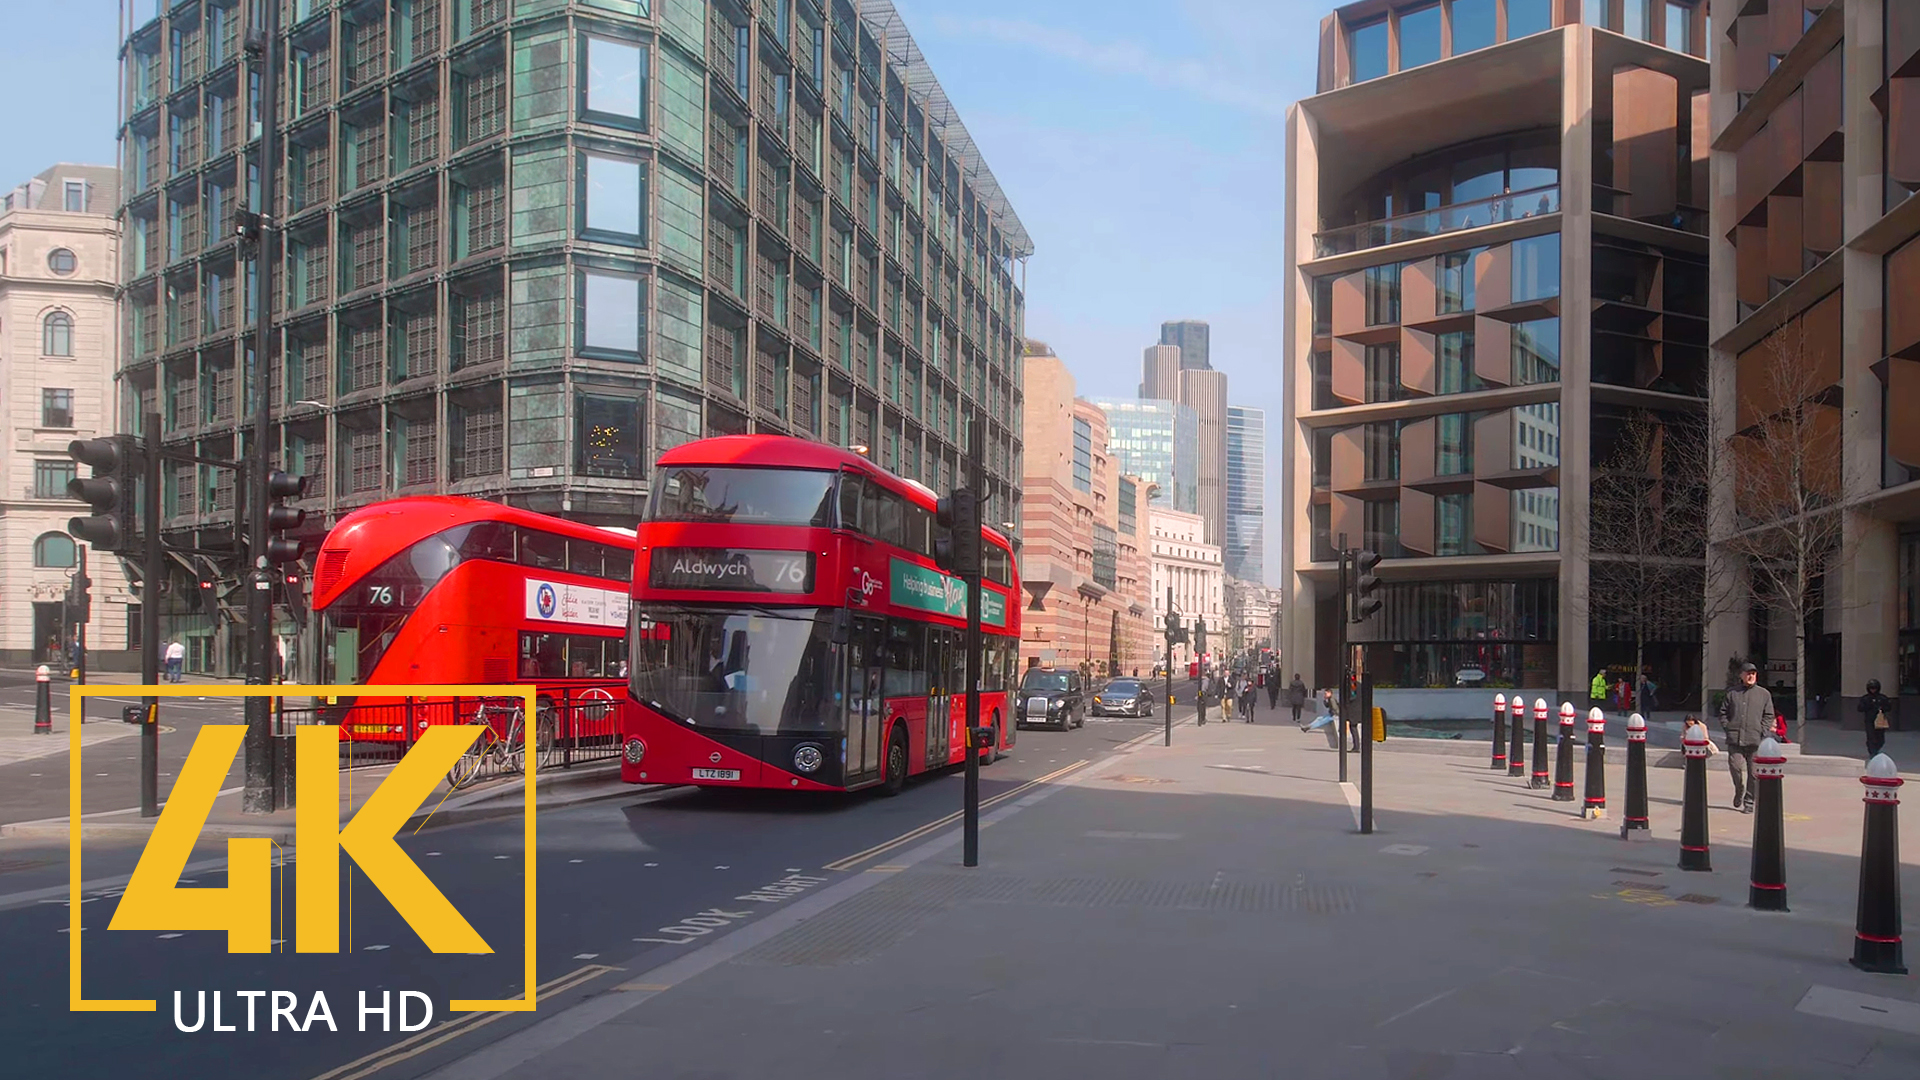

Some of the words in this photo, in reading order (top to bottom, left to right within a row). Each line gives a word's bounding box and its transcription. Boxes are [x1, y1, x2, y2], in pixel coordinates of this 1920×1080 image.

[672, 558, 747, 579] Aldwych
[774, 559, 805, 583] 76
[370, 586, 392, 605] 76
[632, 908, 754, 944] LOOK
[734, 873, 828, 903] RIGHT
